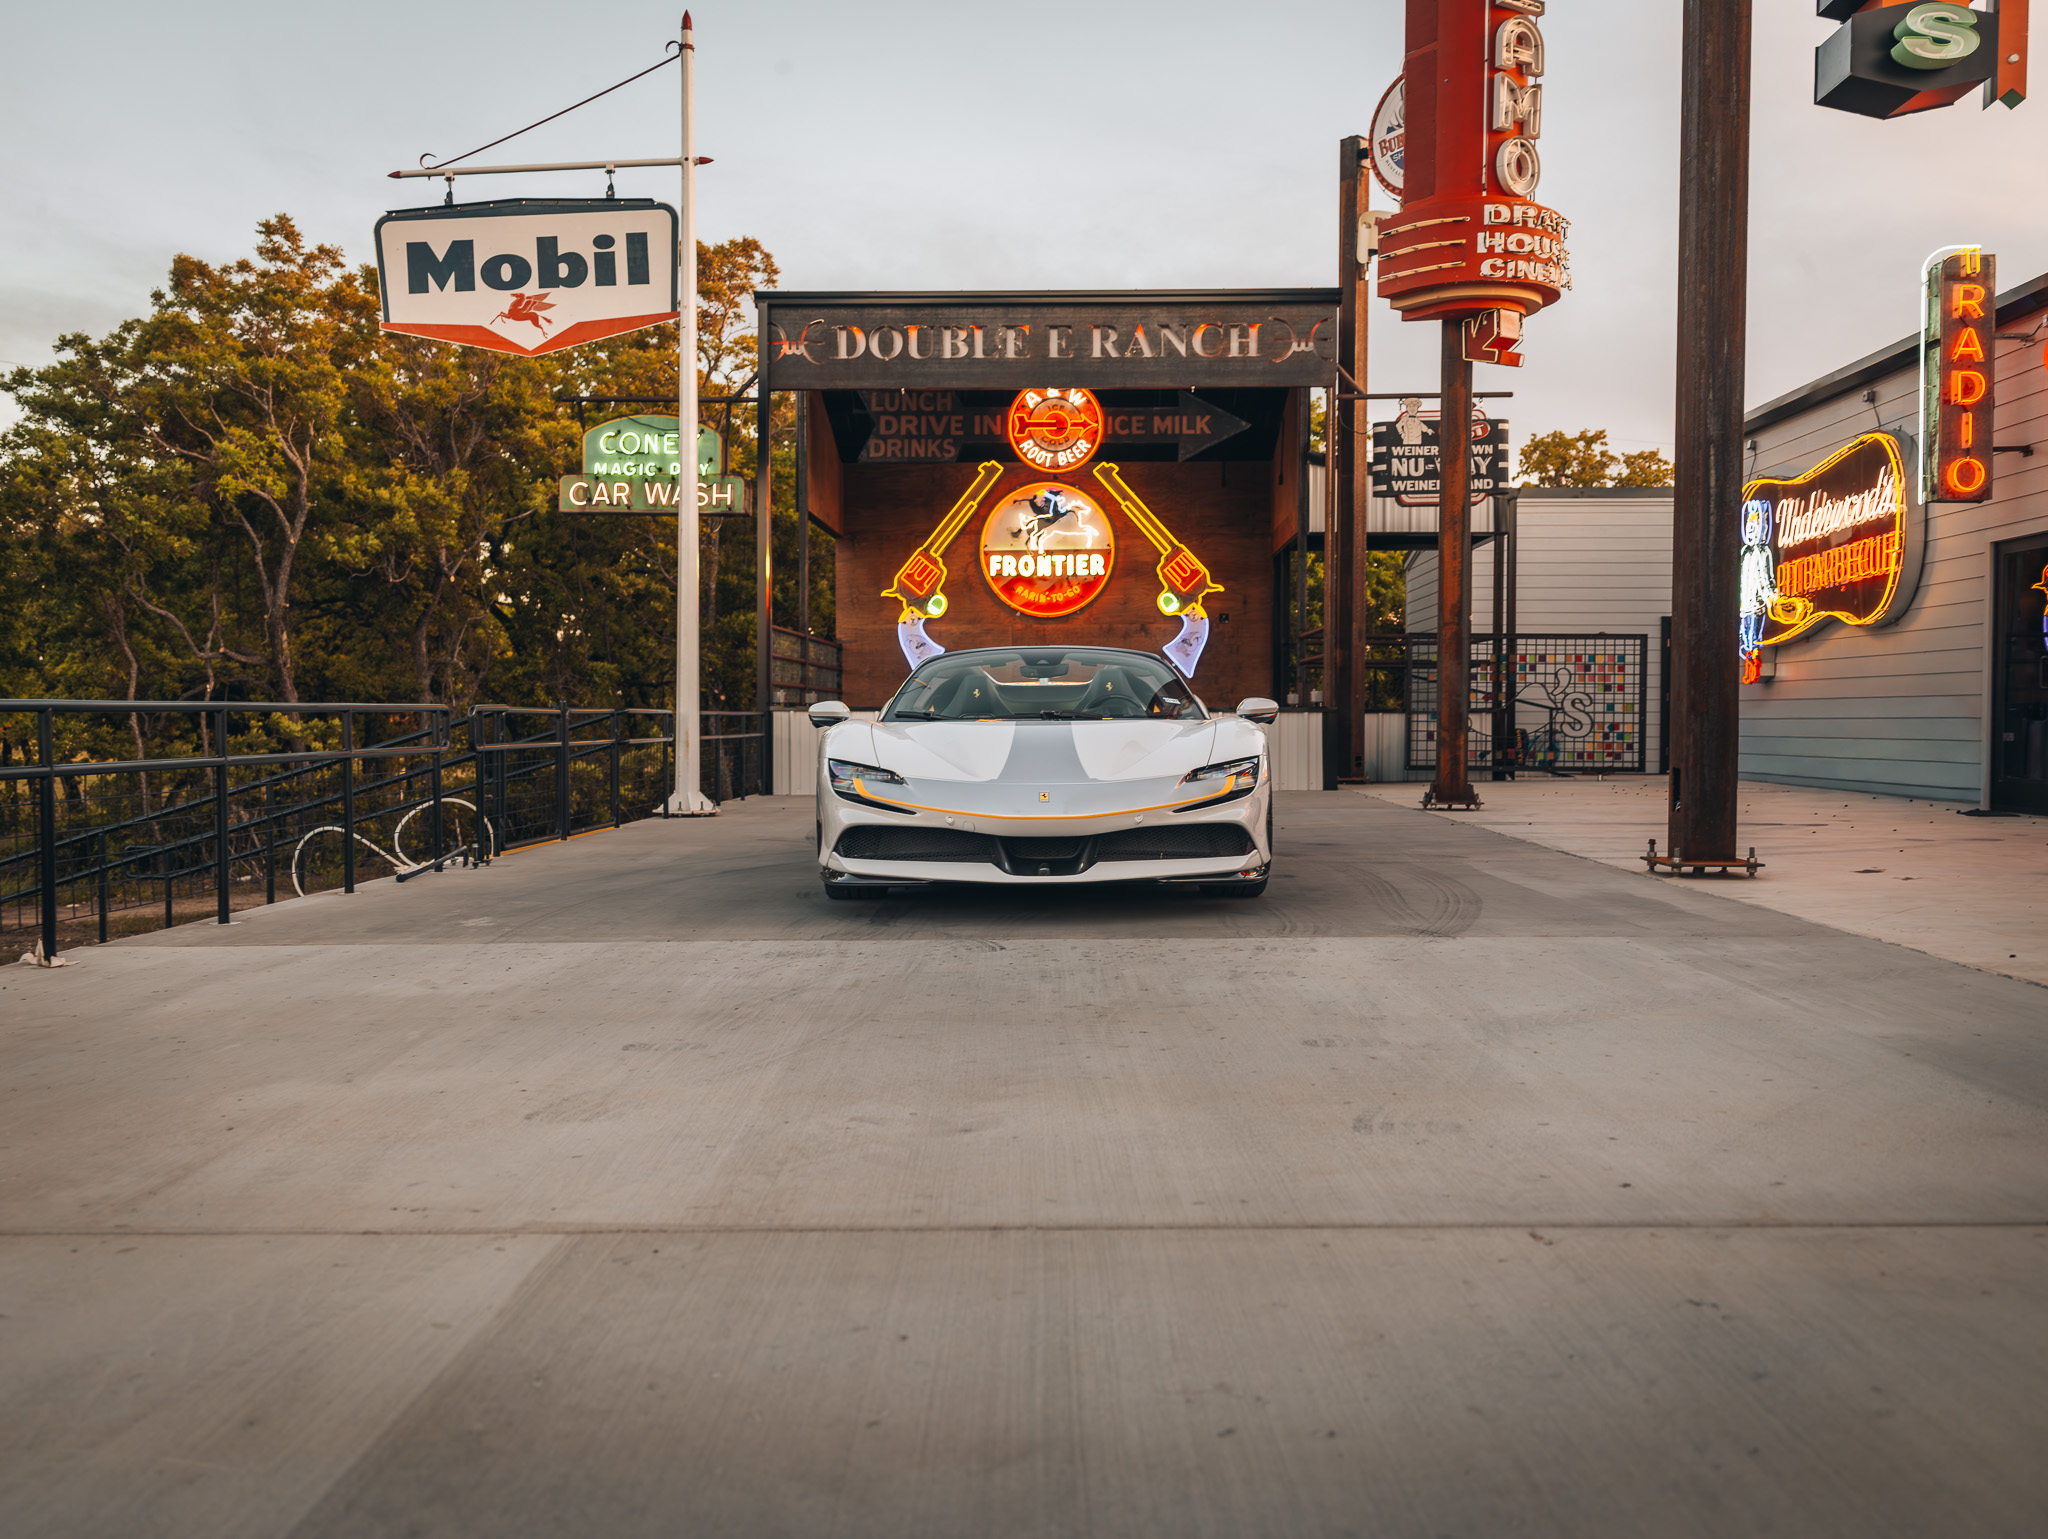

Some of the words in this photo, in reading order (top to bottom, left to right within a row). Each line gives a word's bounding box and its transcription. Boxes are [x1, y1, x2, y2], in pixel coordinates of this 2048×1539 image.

[1494, 0, 1546, 197] AMO
[406, 231, 650, 295] Mobil
[830, 325, 1031, 360] DOUBLE
[1046, 324, 1075, 358] E
[1088, 323, 1263, 358] RANCH
[1947, 284, 1986, 492] RADIO
[870, 392, 952, 412] LUNCH
[879, 415, 964, 435] DRIVE
[974, 415, 1001, 435] IN
[1107, 416, 1145, 435] ICE
[1153, 416, 1212, 435] MILK
[600, 432, 701, 455] CONE
[869, 438, 956, 458] DRINKS
[1019, 440, 1054, 467] ROOT
[1057, 440, 1092, 466] BEER
[1391, 446, 1439, 456] WEINER
[594, 462, 656, 476] MAGIC
[669, 463, 709, 476] DY
[569, 482, 632, 506] CAR
[1391, 480, 1440, 491] WEINE
[1776, 465, 1904, 548] Underwood's
[990, 554, 1106, 577] FRONTIER
[1803, 533, 1902, 590] BARBECUE
